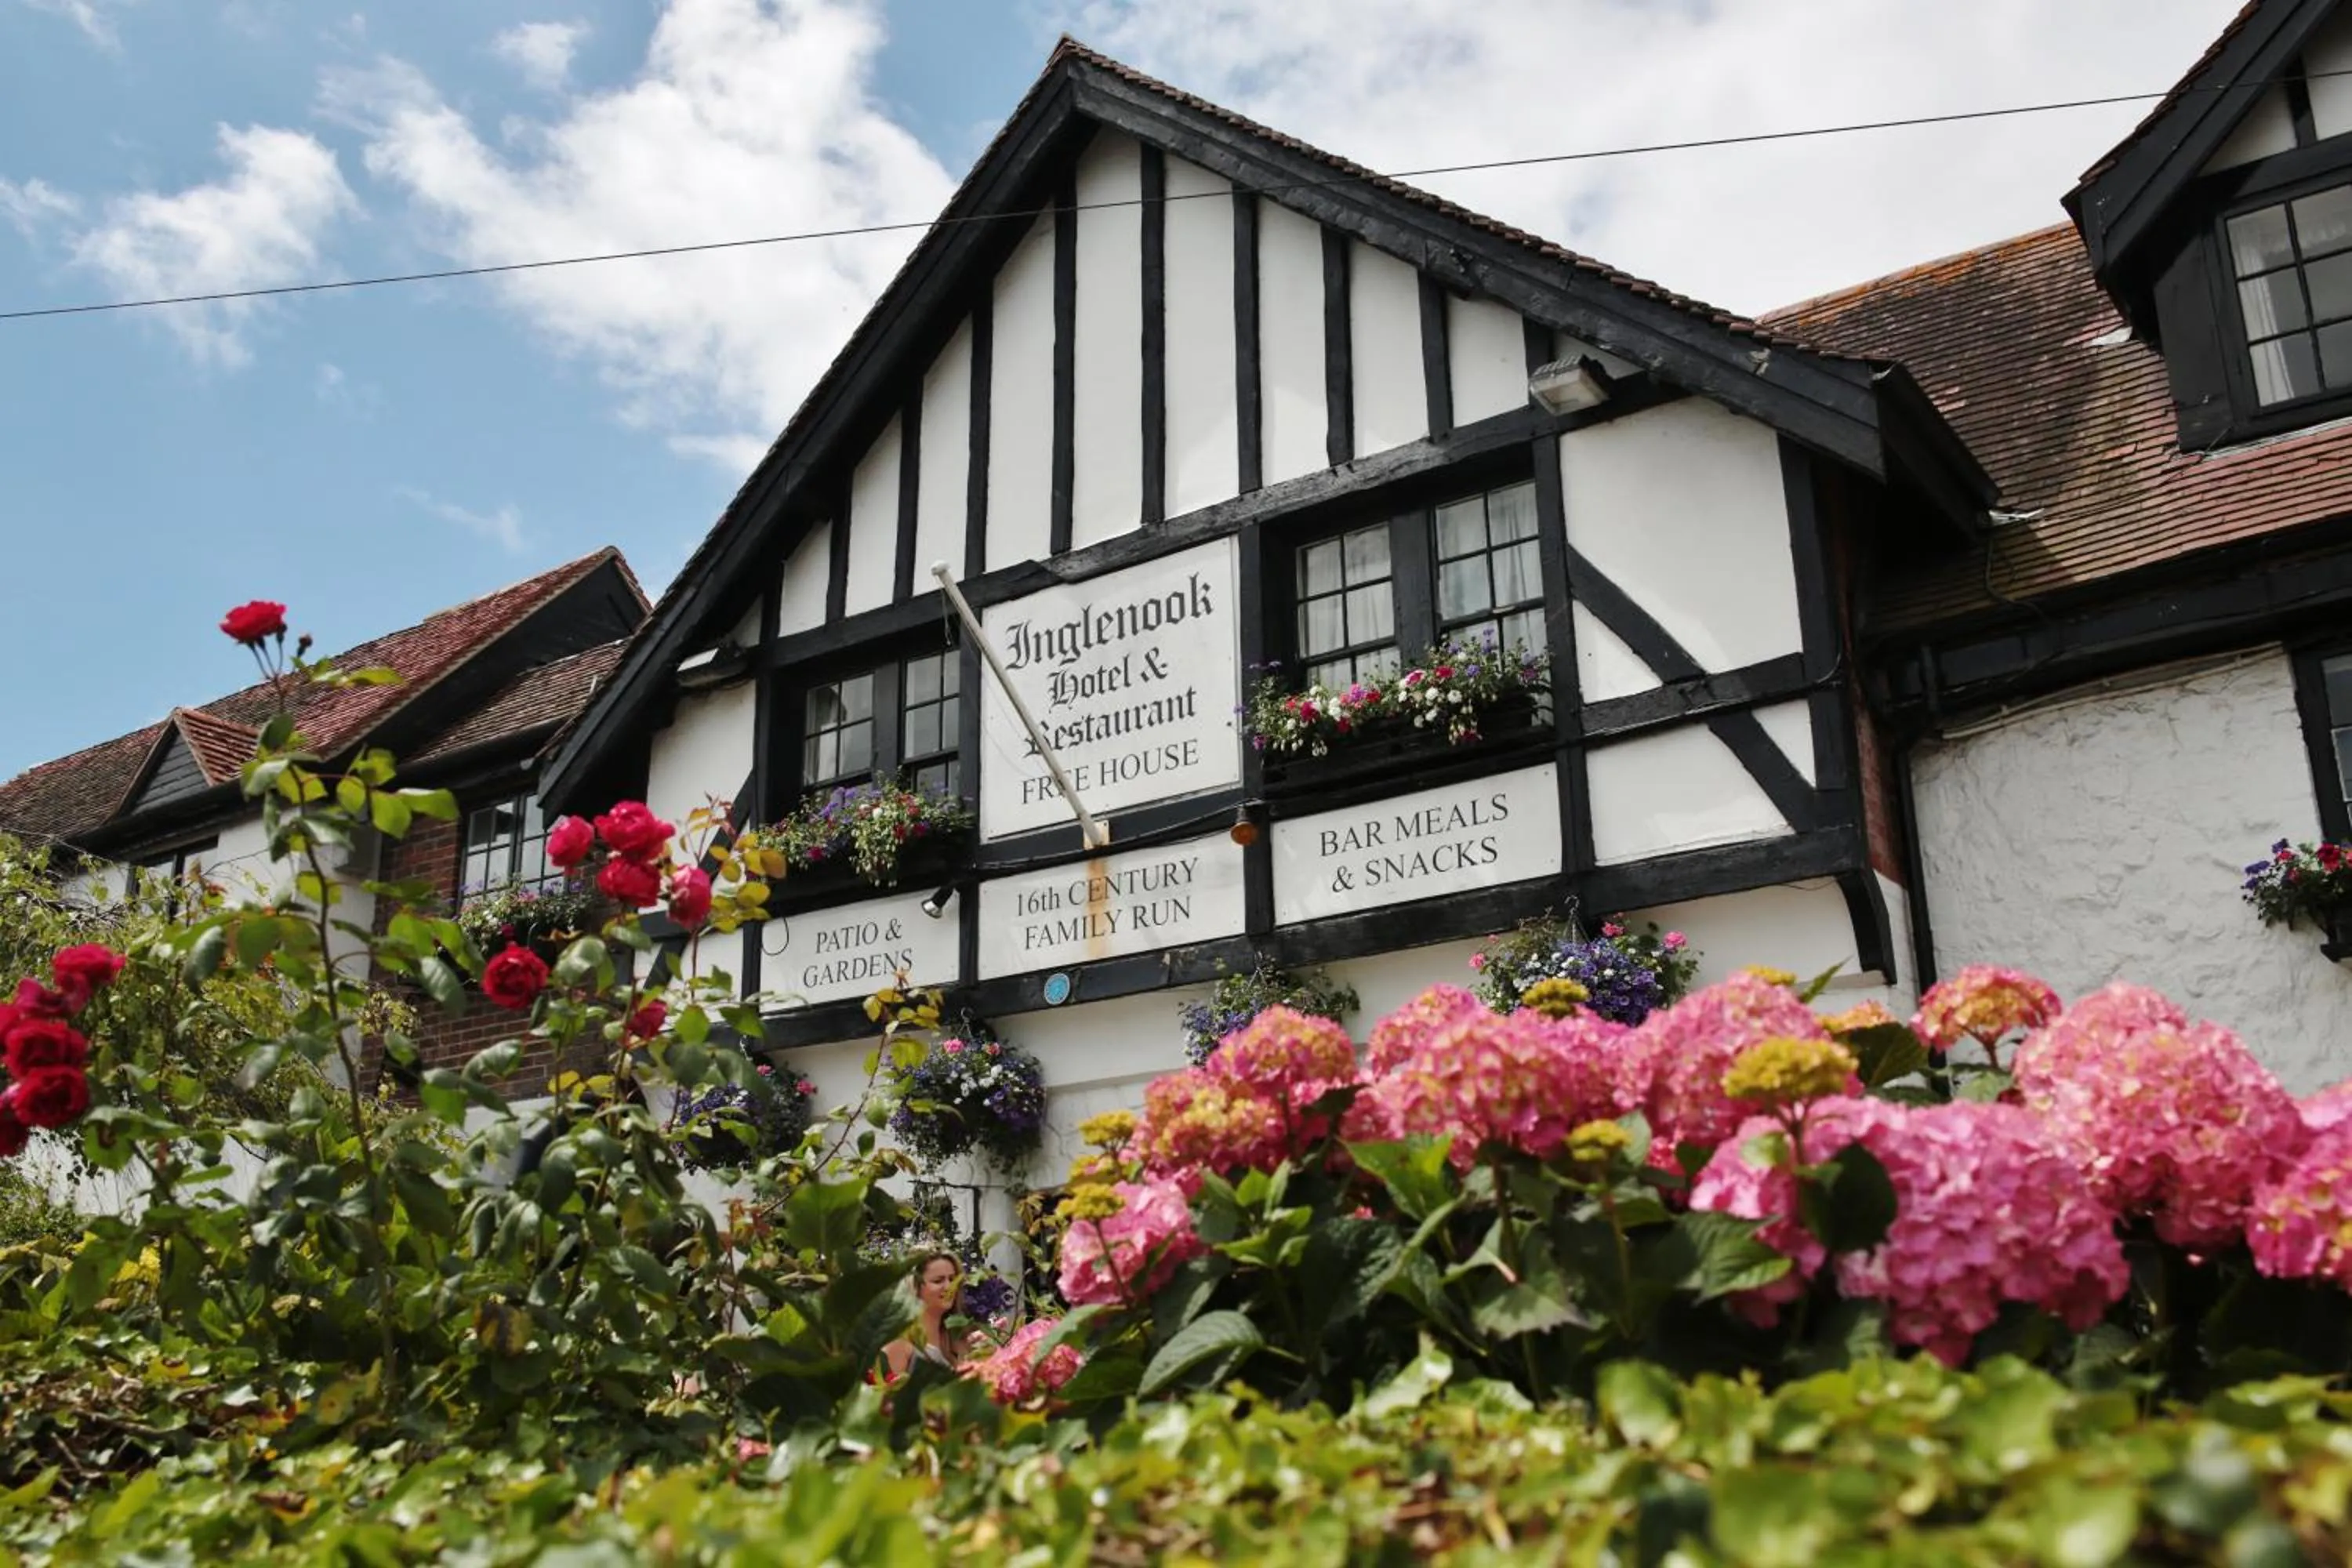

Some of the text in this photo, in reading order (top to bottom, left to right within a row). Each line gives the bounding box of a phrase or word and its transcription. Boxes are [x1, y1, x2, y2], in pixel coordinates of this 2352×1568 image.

[1006, 572, 1213, 670] Inglenook
[1047, 647, 1168, 713] Hotel &
[1022, 686, 1196, 757] Restaurant
[1022, 739, 1200, 804] FRE HOUSE
[1319, 793, 1509, 857] BAR MEALS
[1018, 857, 1199, 916] 16th CENTURY
[1332, 836, 1498, 893] & SNACKS
[815, 918, 902, 954] PATIO &
[1025, 896, 1191, 950] FAMILY RUN
[804, 948, 913, 988] GARDENS
